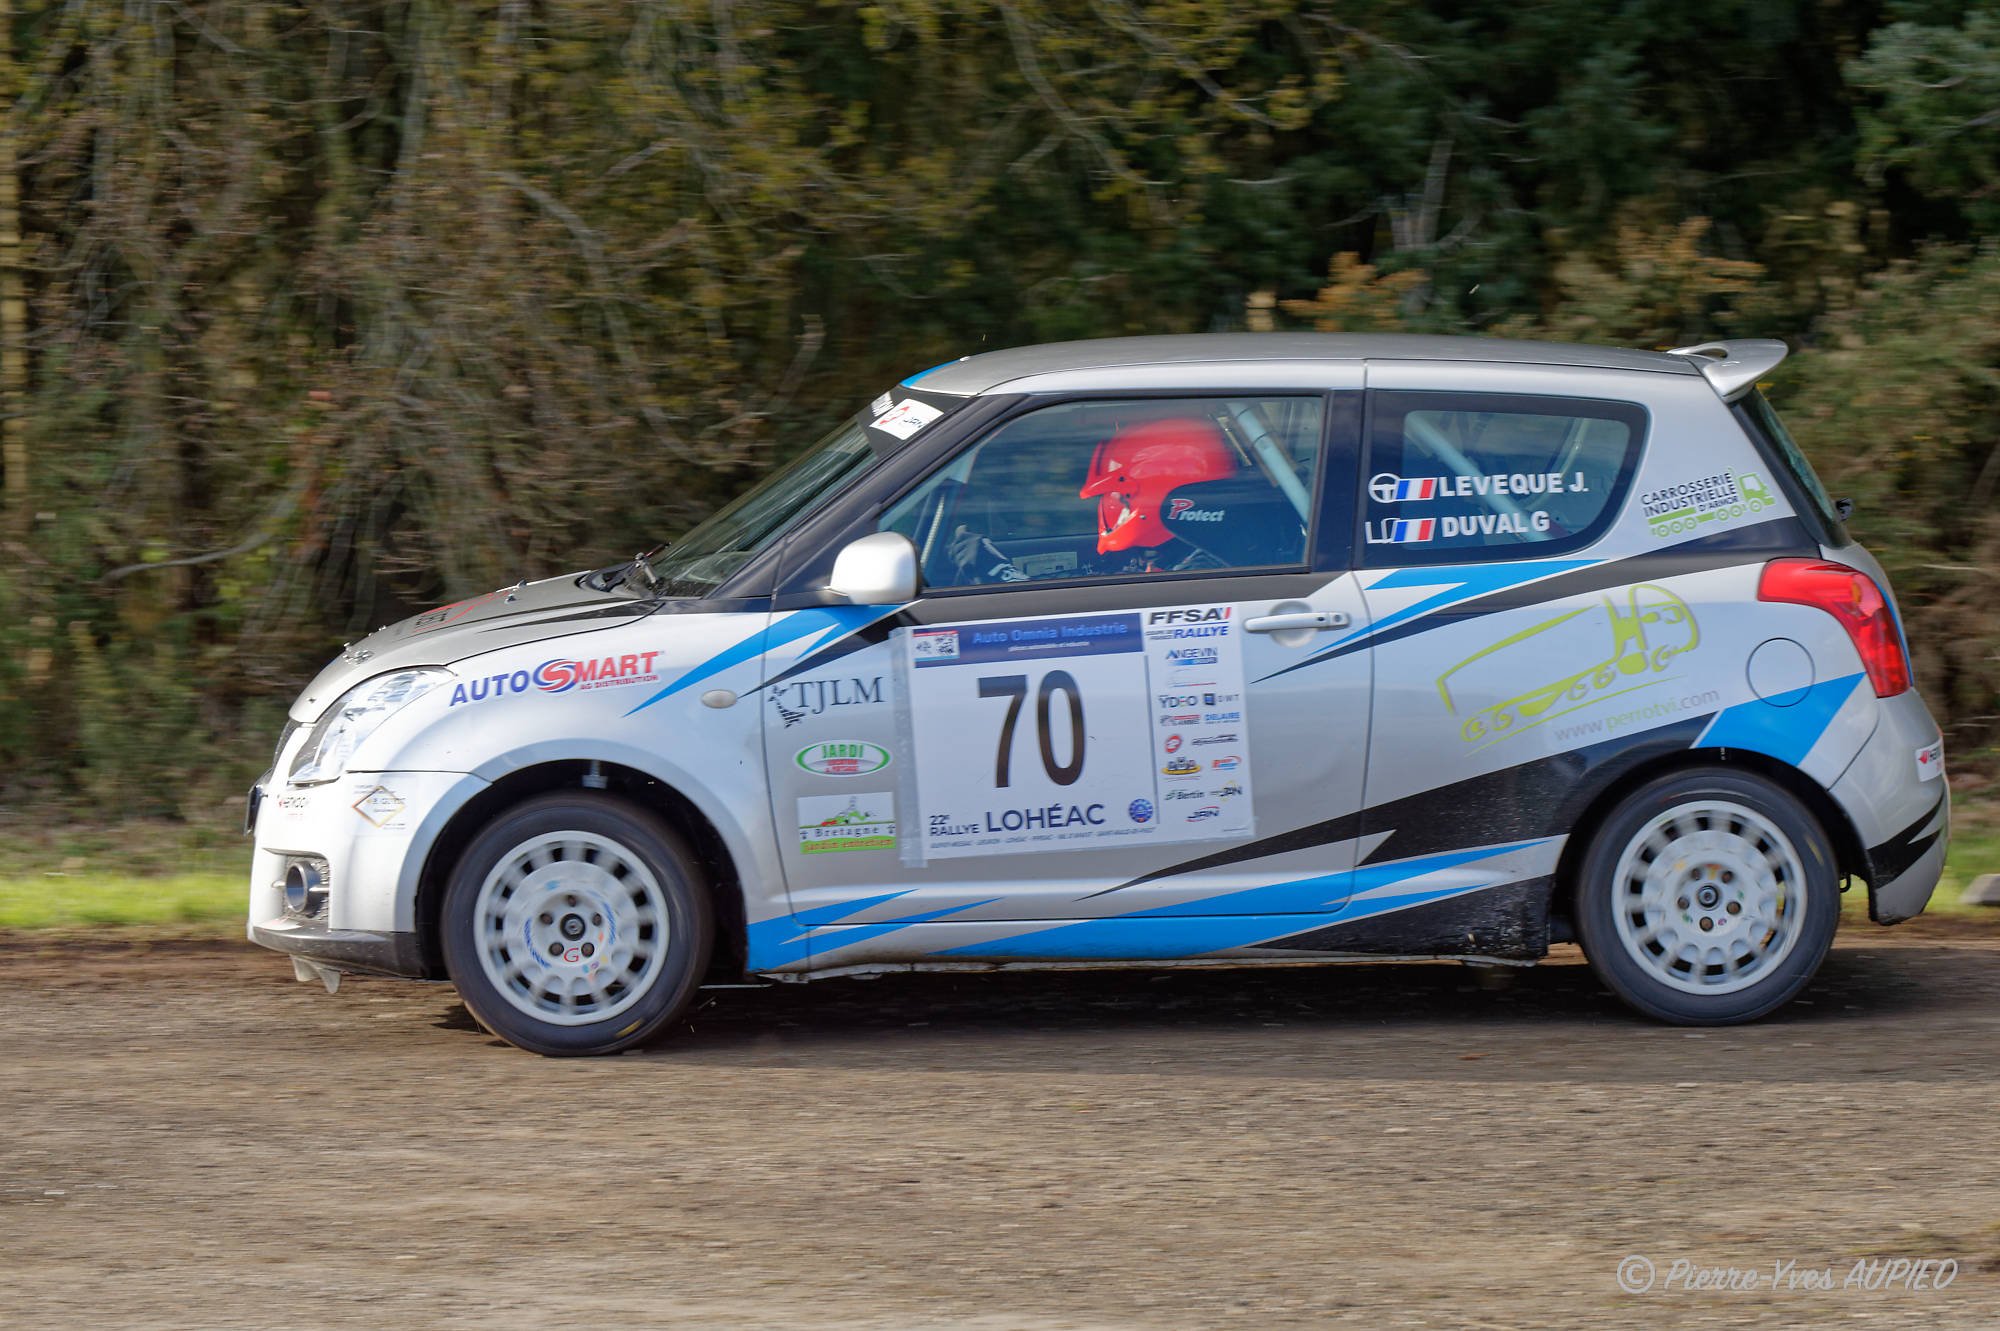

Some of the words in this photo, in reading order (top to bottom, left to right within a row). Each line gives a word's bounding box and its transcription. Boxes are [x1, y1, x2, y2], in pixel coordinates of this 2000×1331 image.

[1439, 472, 1564, 497] LEVEQUE
[1569, 471, 1589, 493] J.
[1640, 472, 1733, 505] CARROSSERIE
[1168, 498, 1225, 522] Protect
[1643, 483, 1737, 517] INDUSTRIELLE
[1698, 495, 1739, 512] D'ARMOR
[1441, 513, 1529, 538] DUVAL
[1531, 510, 1551, 532] G
[1149, 607, 1223, 625] FFSA
[972, 631, 1008, 645] Auto
[1010, 628, 1058, 642] Omnia
[1060, 621, 1128, 638] Industrie
[1174, 626, 1230, 639] RALLYE
[791, 676, 886, 714] TJLM
[977, 669, 1087, 788] 70
[928, 823, 981, 837] RALLYE
[984, 803, 1106, 833] LOHÉAC
